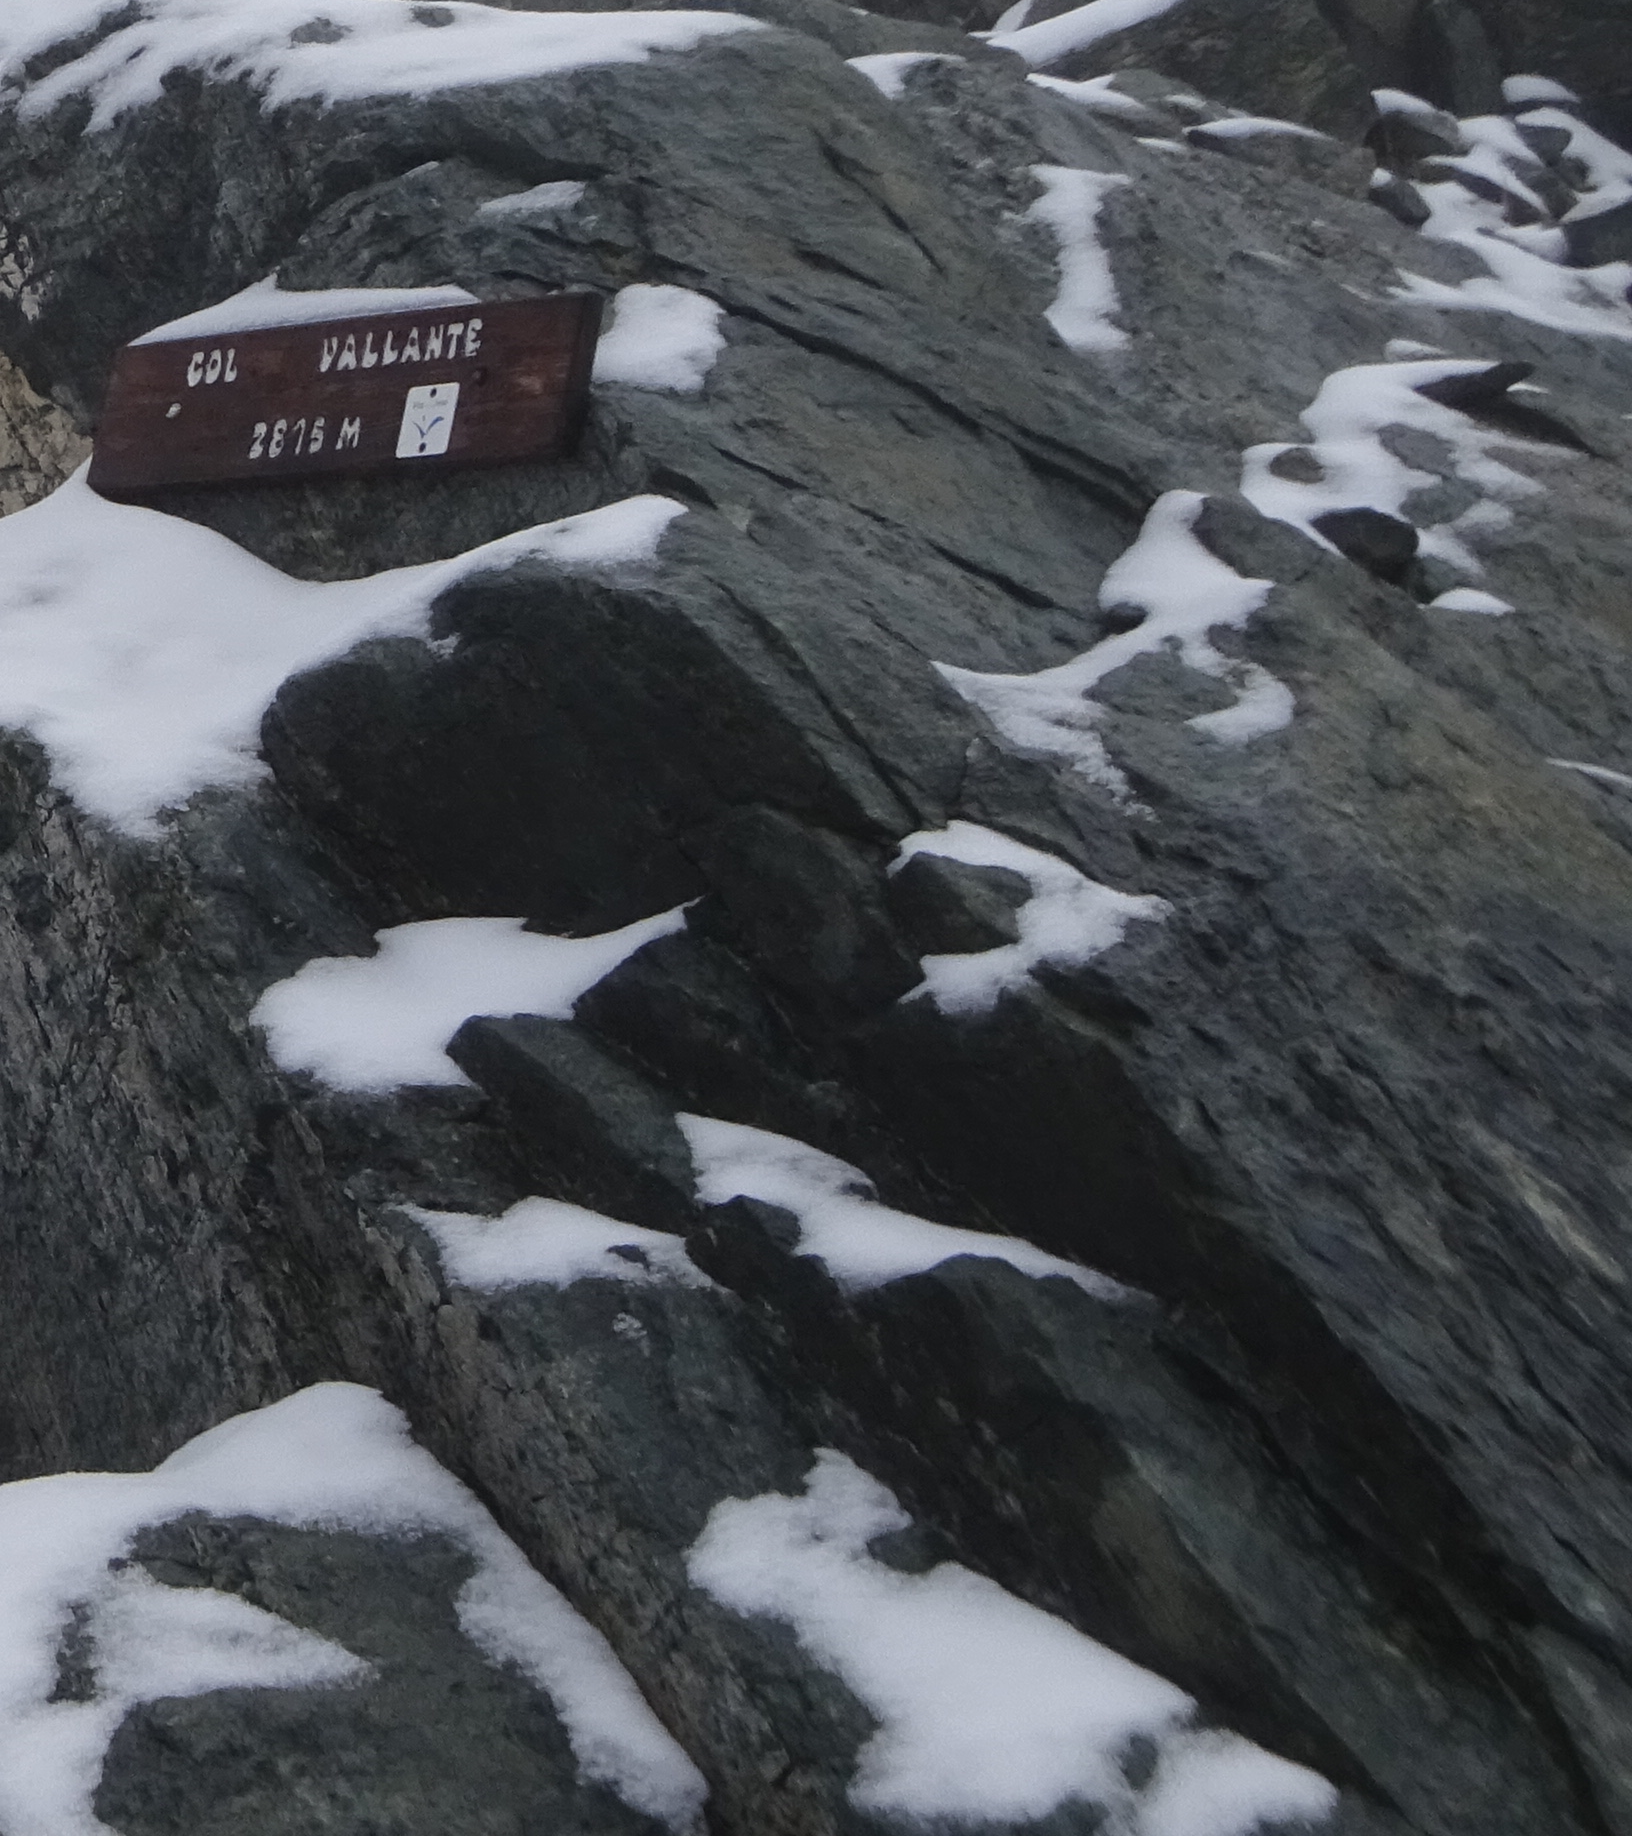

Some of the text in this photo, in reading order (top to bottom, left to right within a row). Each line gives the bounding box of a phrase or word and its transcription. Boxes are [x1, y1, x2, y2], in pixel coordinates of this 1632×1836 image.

[187, 318, 483, 387] COL VALLANTE
[335, 416, 361, 450] M
